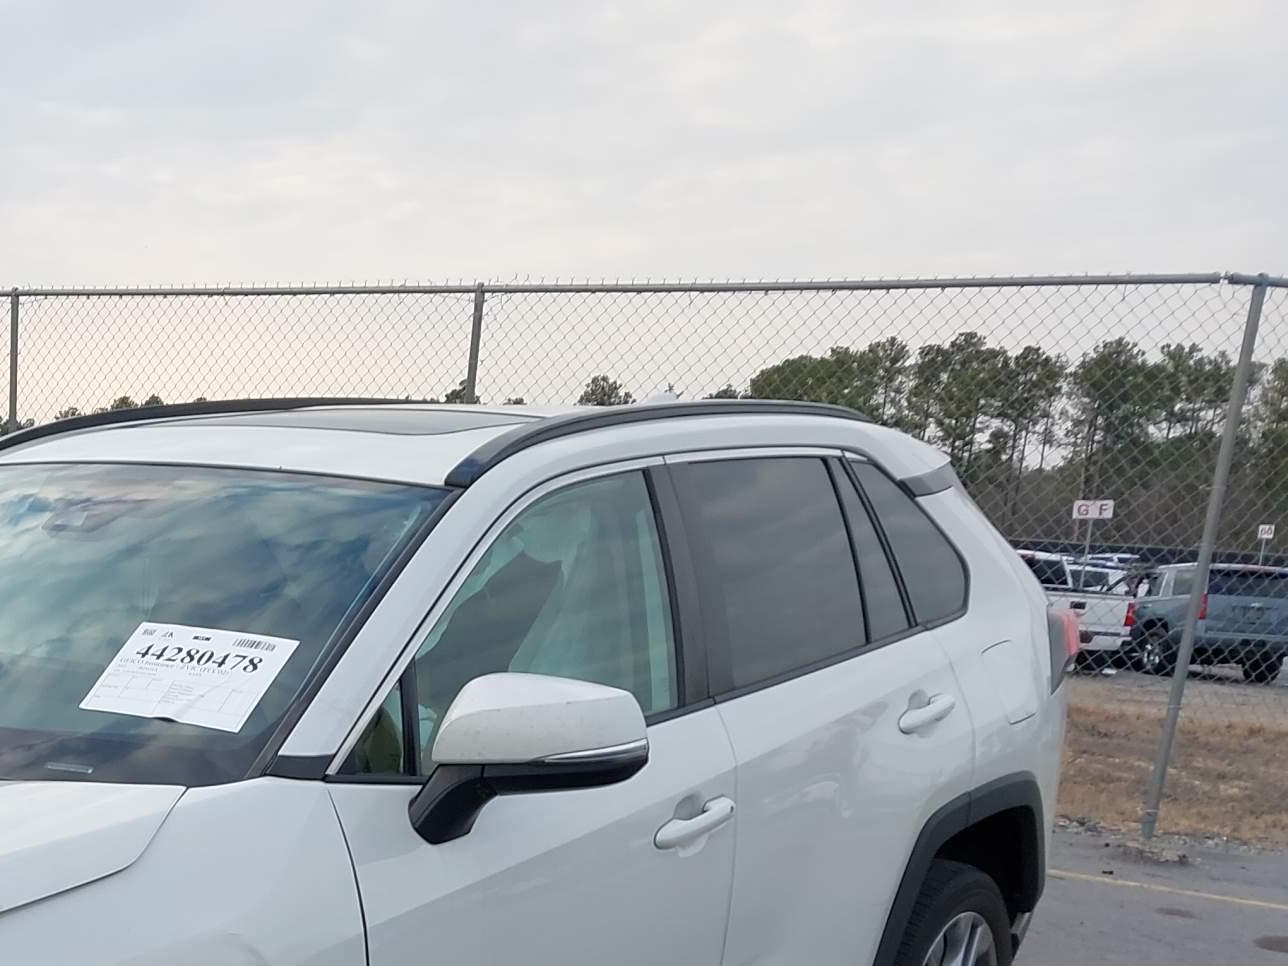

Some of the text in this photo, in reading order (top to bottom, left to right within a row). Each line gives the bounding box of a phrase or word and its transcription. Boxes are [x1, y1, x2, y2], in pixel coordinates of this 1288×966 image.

[1077, 503, 1108, 516] G F
[136, 643, 263, 673] 44280478
